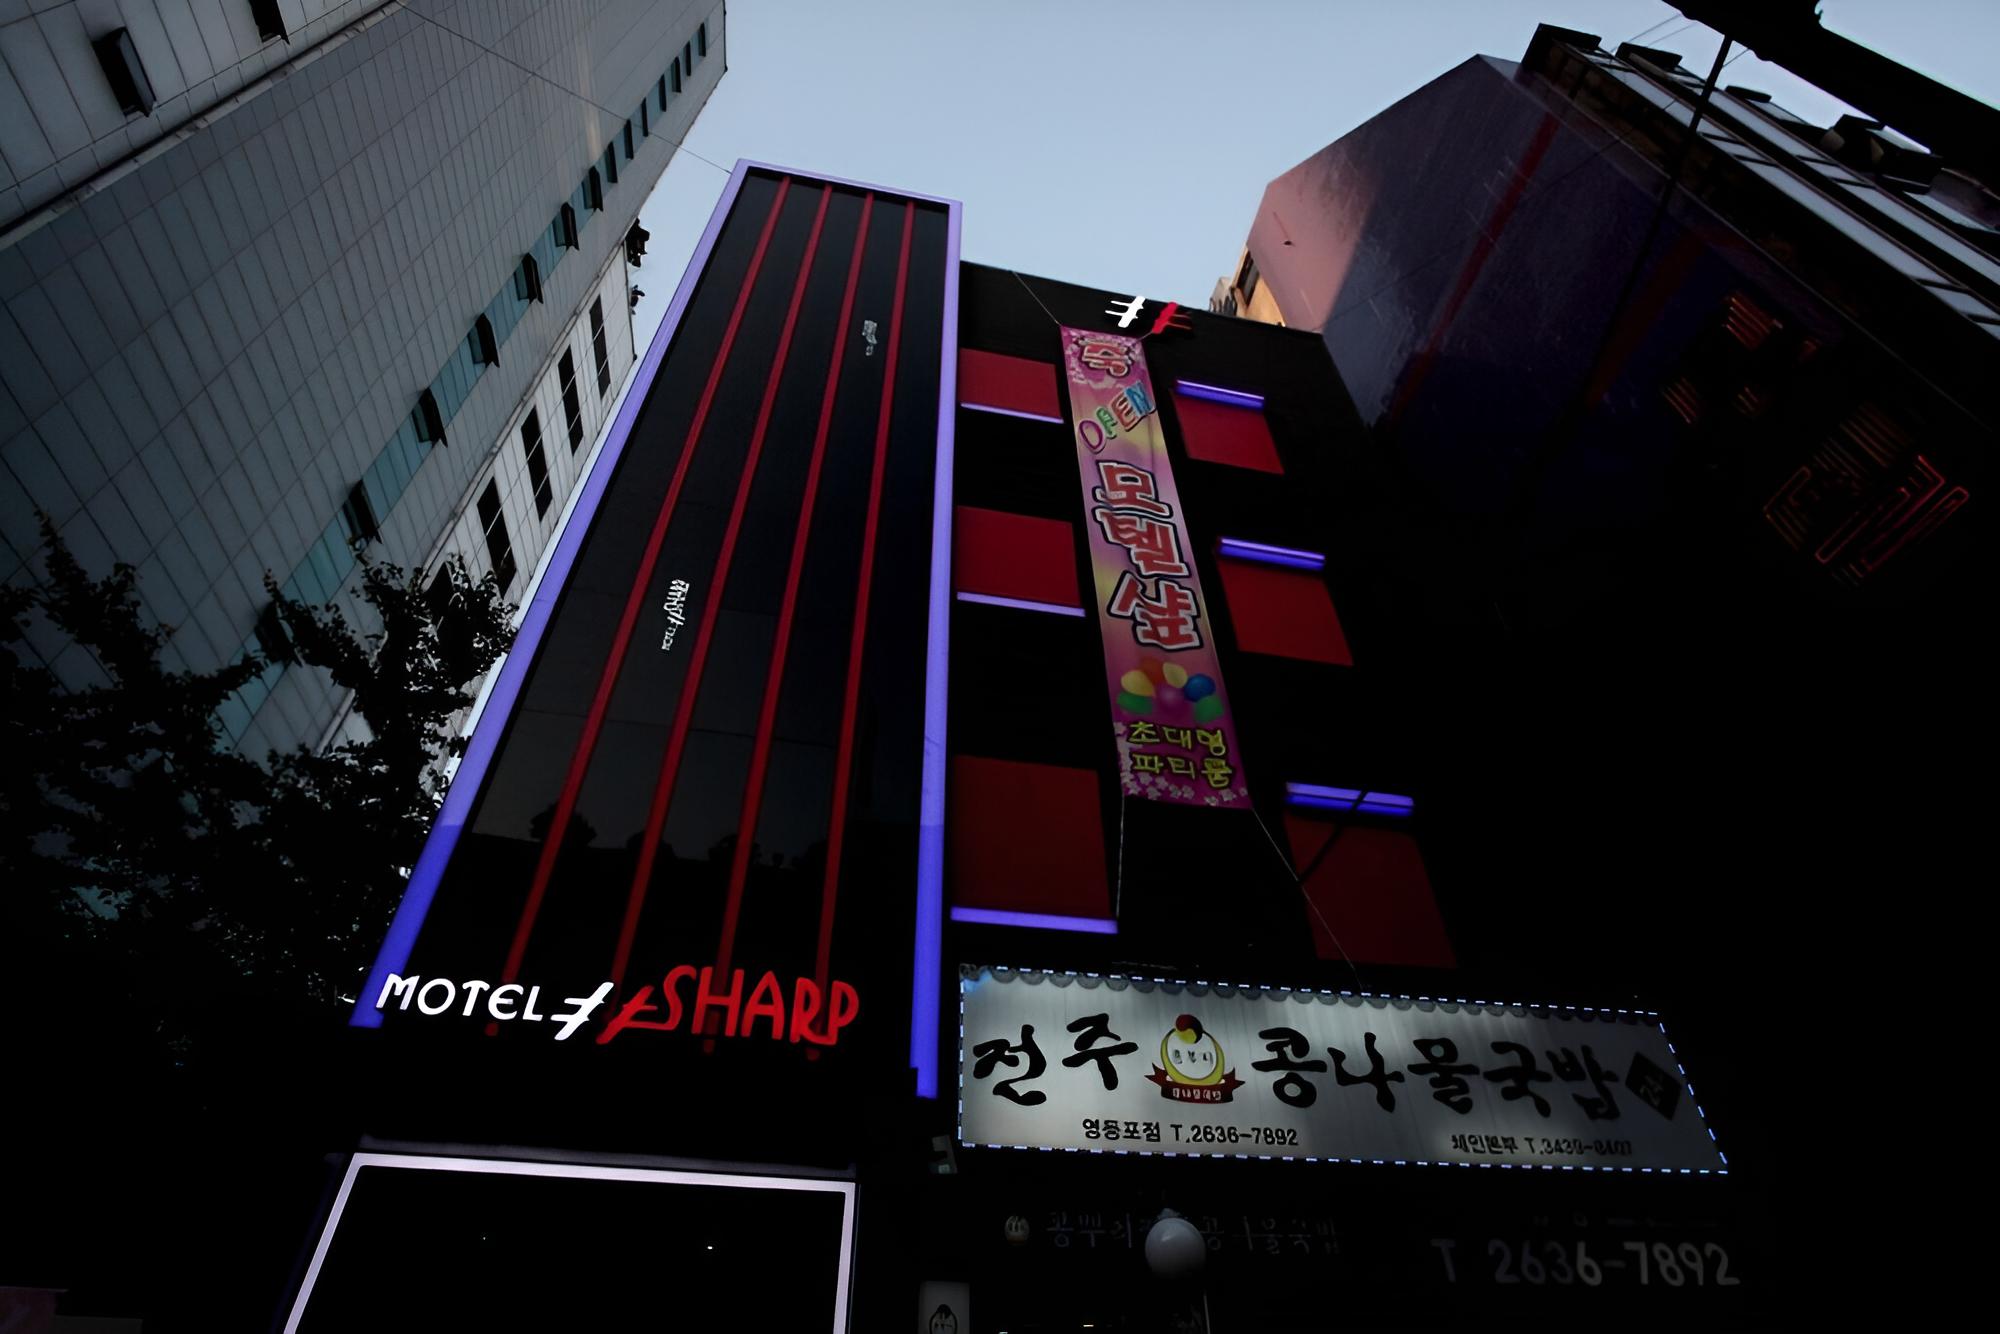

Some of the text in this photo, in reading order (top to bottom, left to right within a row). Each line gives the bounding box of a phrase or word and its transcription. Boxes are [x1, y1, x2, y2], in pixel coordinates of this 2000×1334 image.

[1079, 380, 1157, 454] OPEN
[375, 963, 861, 1046] MOTEL SHARP
[973, 1013, 1622, 1119] 전주 콩나물국밥
[1082, 1118, 1162, 1143] 영등포점
[1486, 1237, 1743, 1289] 2636-7892
